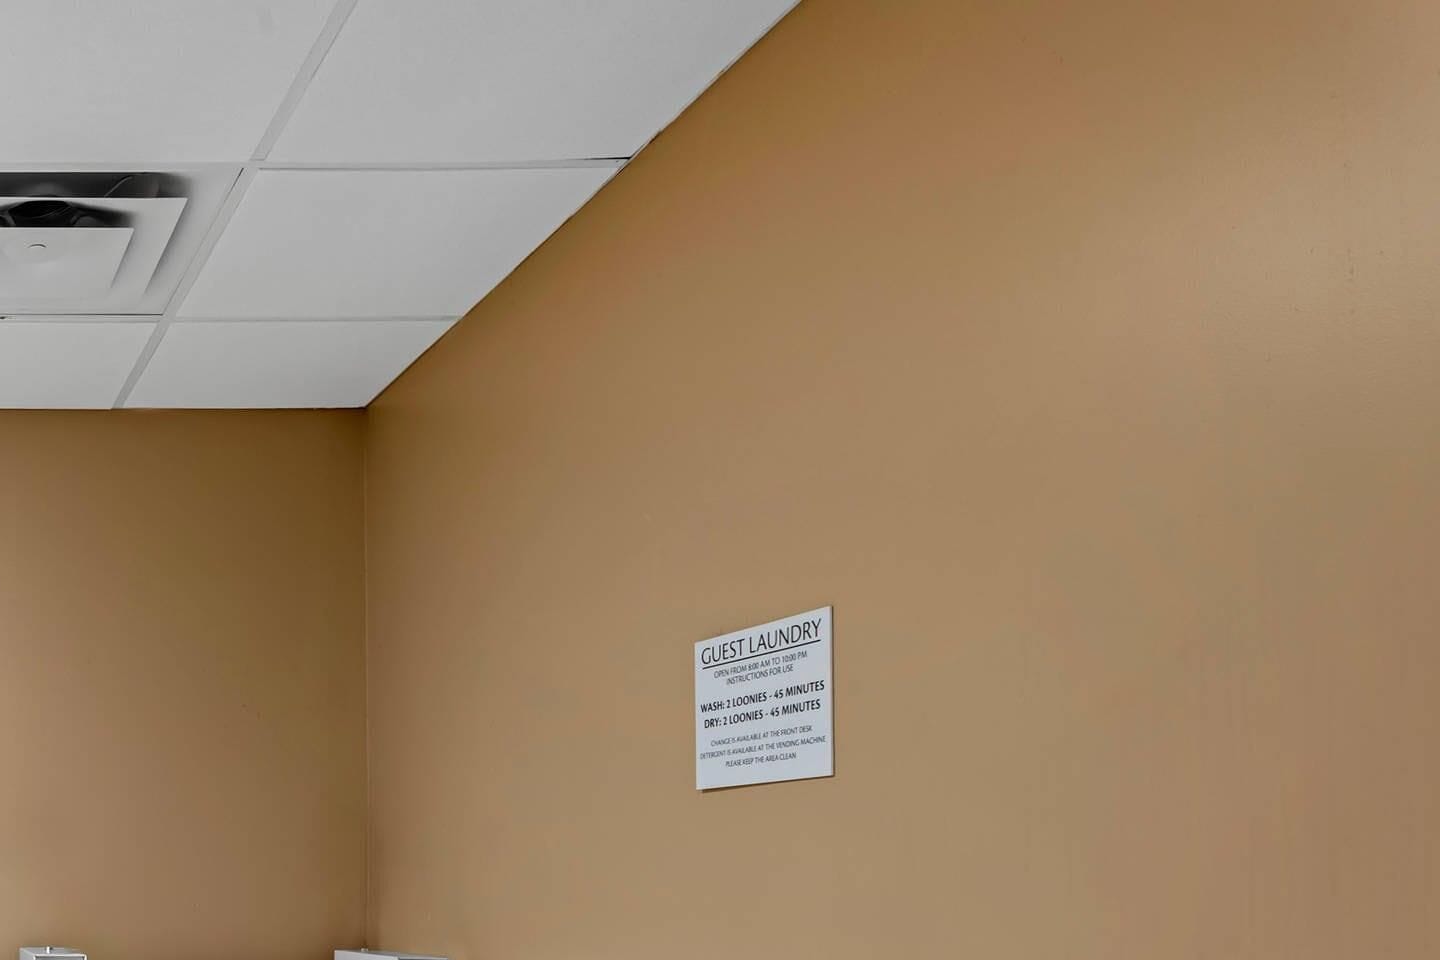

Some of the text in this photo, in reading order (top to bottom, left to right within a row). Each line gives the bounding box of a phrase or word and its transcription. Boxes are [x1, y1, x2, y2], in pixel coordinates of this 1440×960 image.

[701, 618, 821, 665] GUEST LAUNDRY
[714, 668, 729, 678] OPEN
[730, 665, 747, 675] FROM
[760, 660, 770, 668] AM
[771, 657, 780, 666] TO
[797, 650, 808, 660] PM
[726, 664, 794, 685] INSTRUCTIONS FOR USE
[700, 702, 725, 713] WASH:
[726, 699, 731, 709] 2
[732, 692, 767, 708] LOONIES
[774, 689, 784, 699] 45
[785, 680, 825, 697] MINUTES
[704, 718, 722, 729] DRY:
[723, 716, 728, 726] 2
[729, 709, 763, 725] LOONIES
[770, 707, 779, 717] 45
[781, 699, 821, 715] MINUTES
[775, 738, 800, 749] VENDING
[801, 735, 826, 745] MACHINE
[780, 727, 798, 736] FRONT
